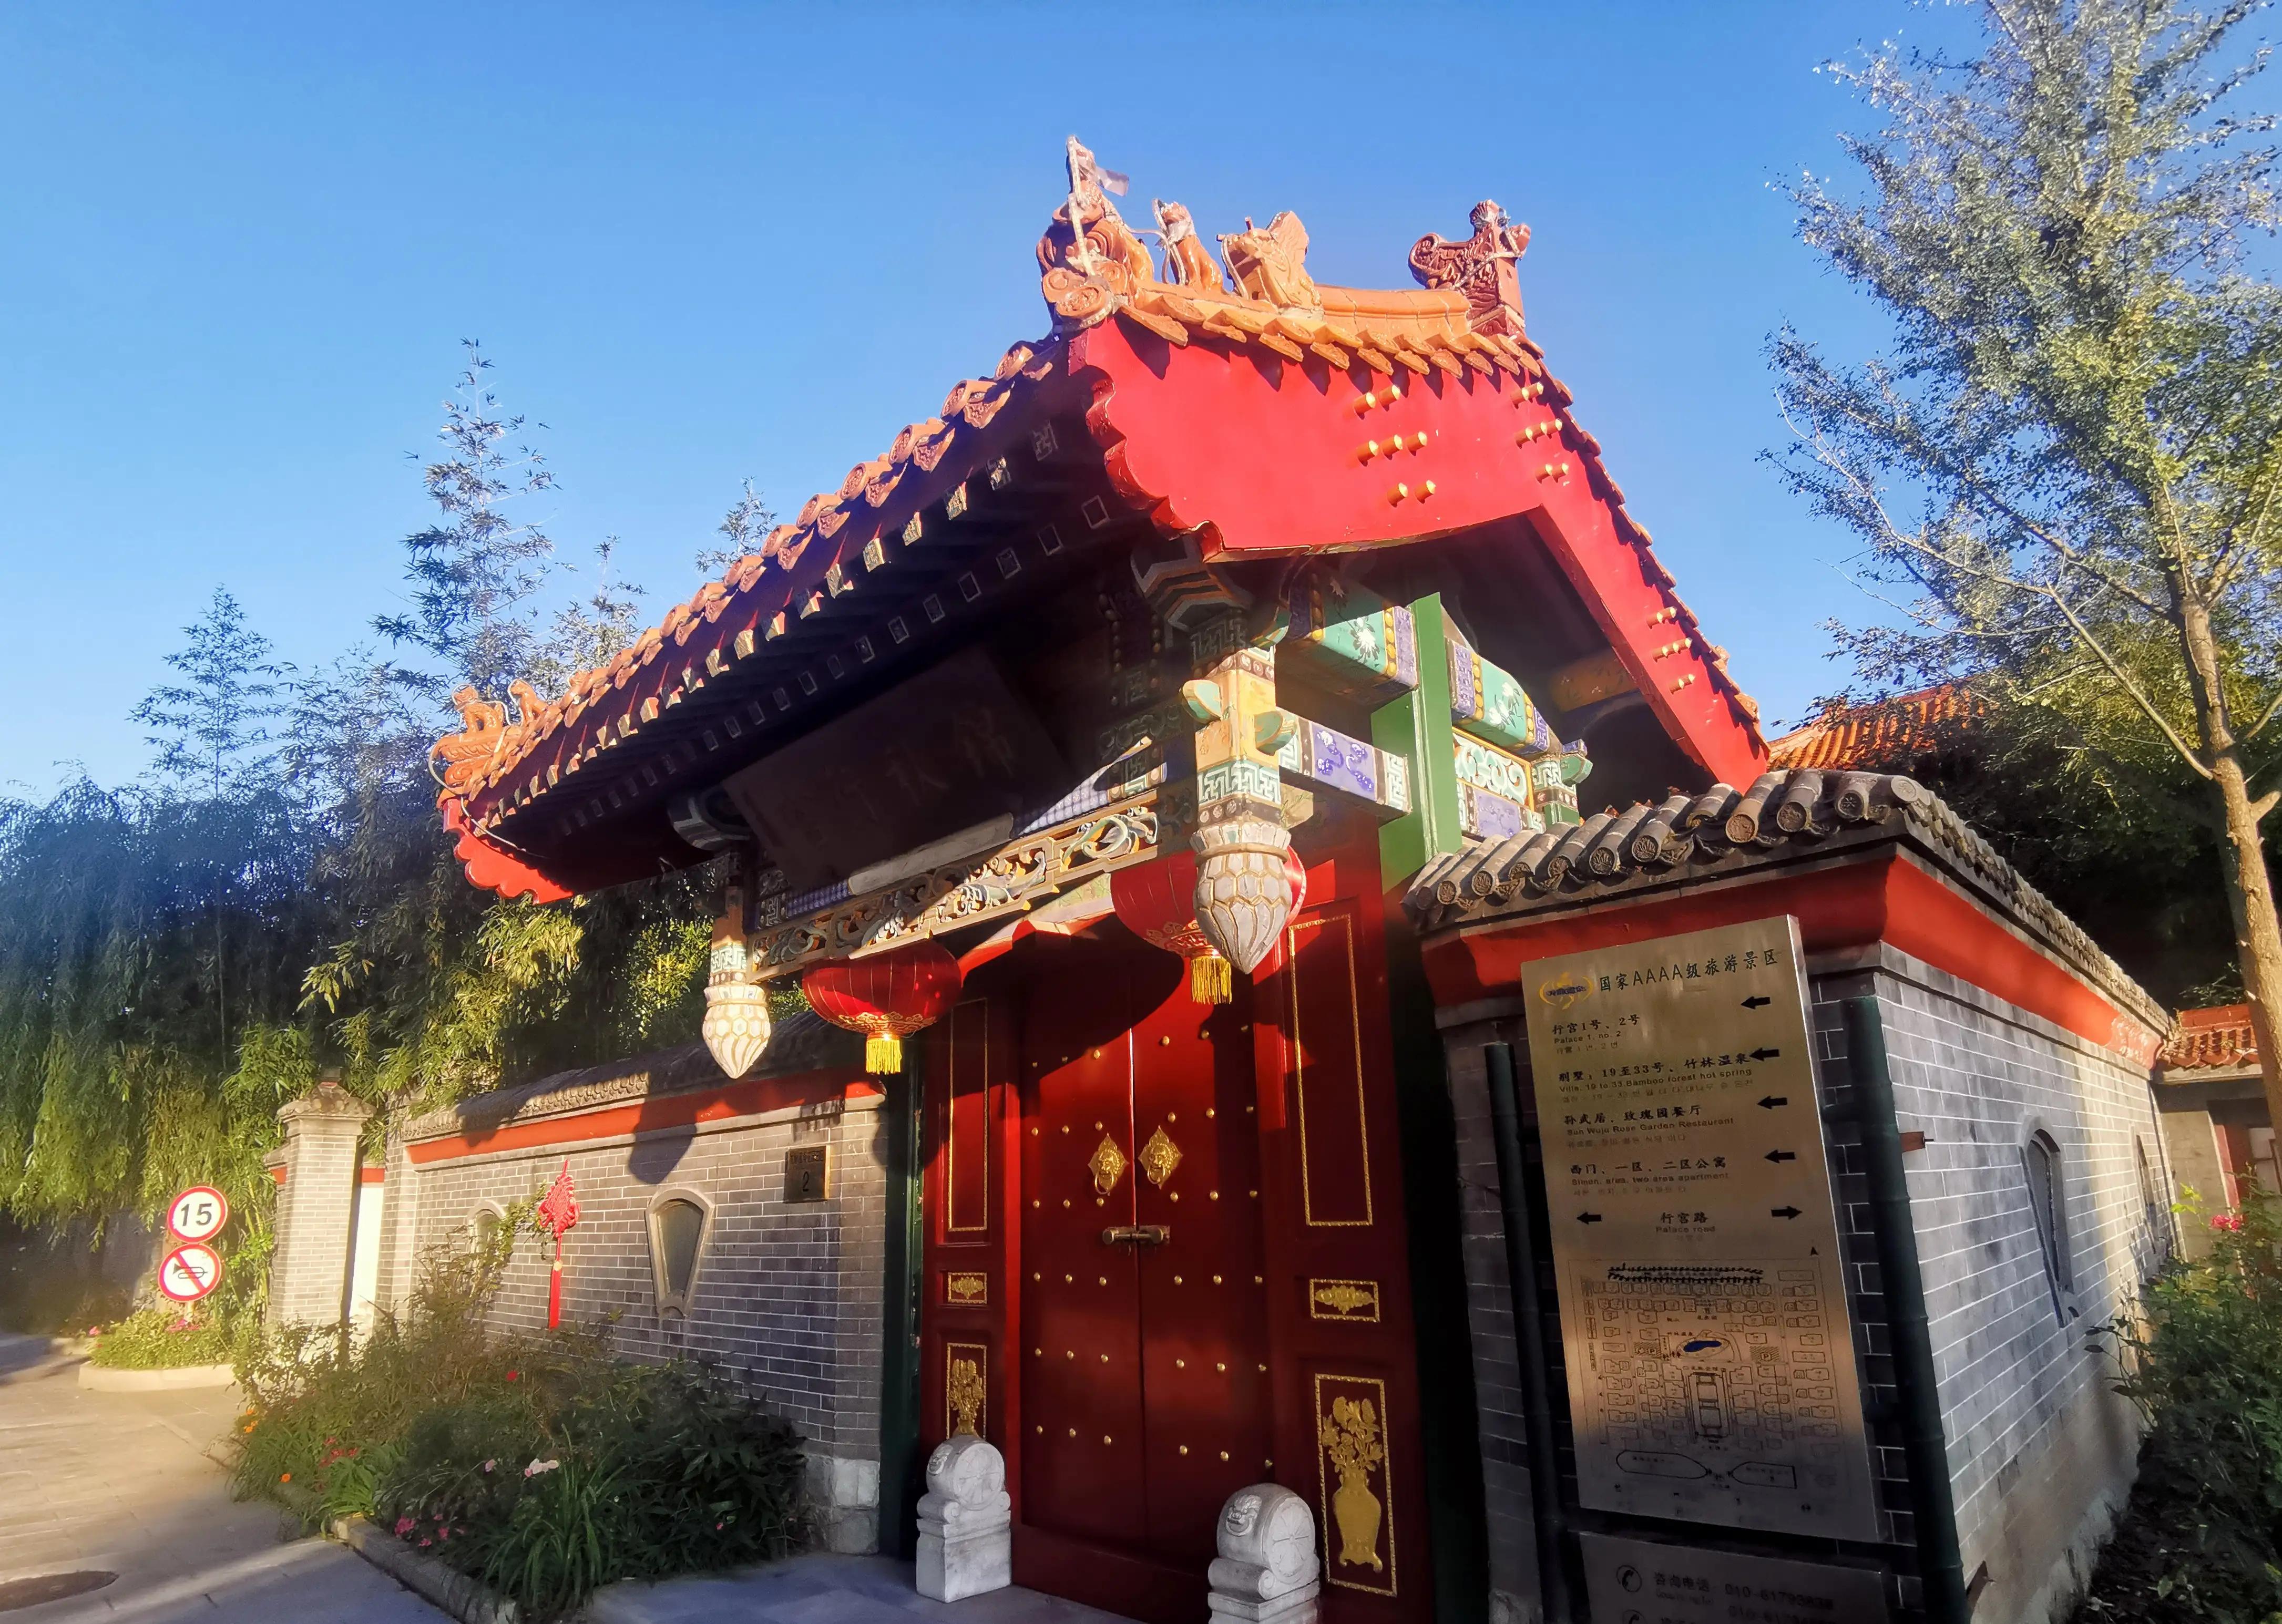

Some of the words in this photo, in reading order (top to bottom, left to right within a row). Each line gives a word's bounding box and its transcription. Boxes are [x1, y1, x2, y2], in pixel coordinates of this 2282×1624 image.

[1600, 949, 1778, 992] 国家AAAA级旅游景区
[1554, 1036, 1583, 1044] Palace
[1585, 1082, 1596, 1090] 19
[1668, 1074, 1696, 1083] forest
[1720, 1068, 1752, 1078] spring
[1613, 1125, 1635, 1133] Rose
[1640, 1122, 1675, 1130] Garden
[1679, 1117, 1734, 1128] Restaurant
[802, 1171, 810, 1192] 2
[1678, 1173, 1729, 1182] apartment
[180, 1202, 212, 1227] 15
[1660, 1211, 1708, 1225] 行宫路
